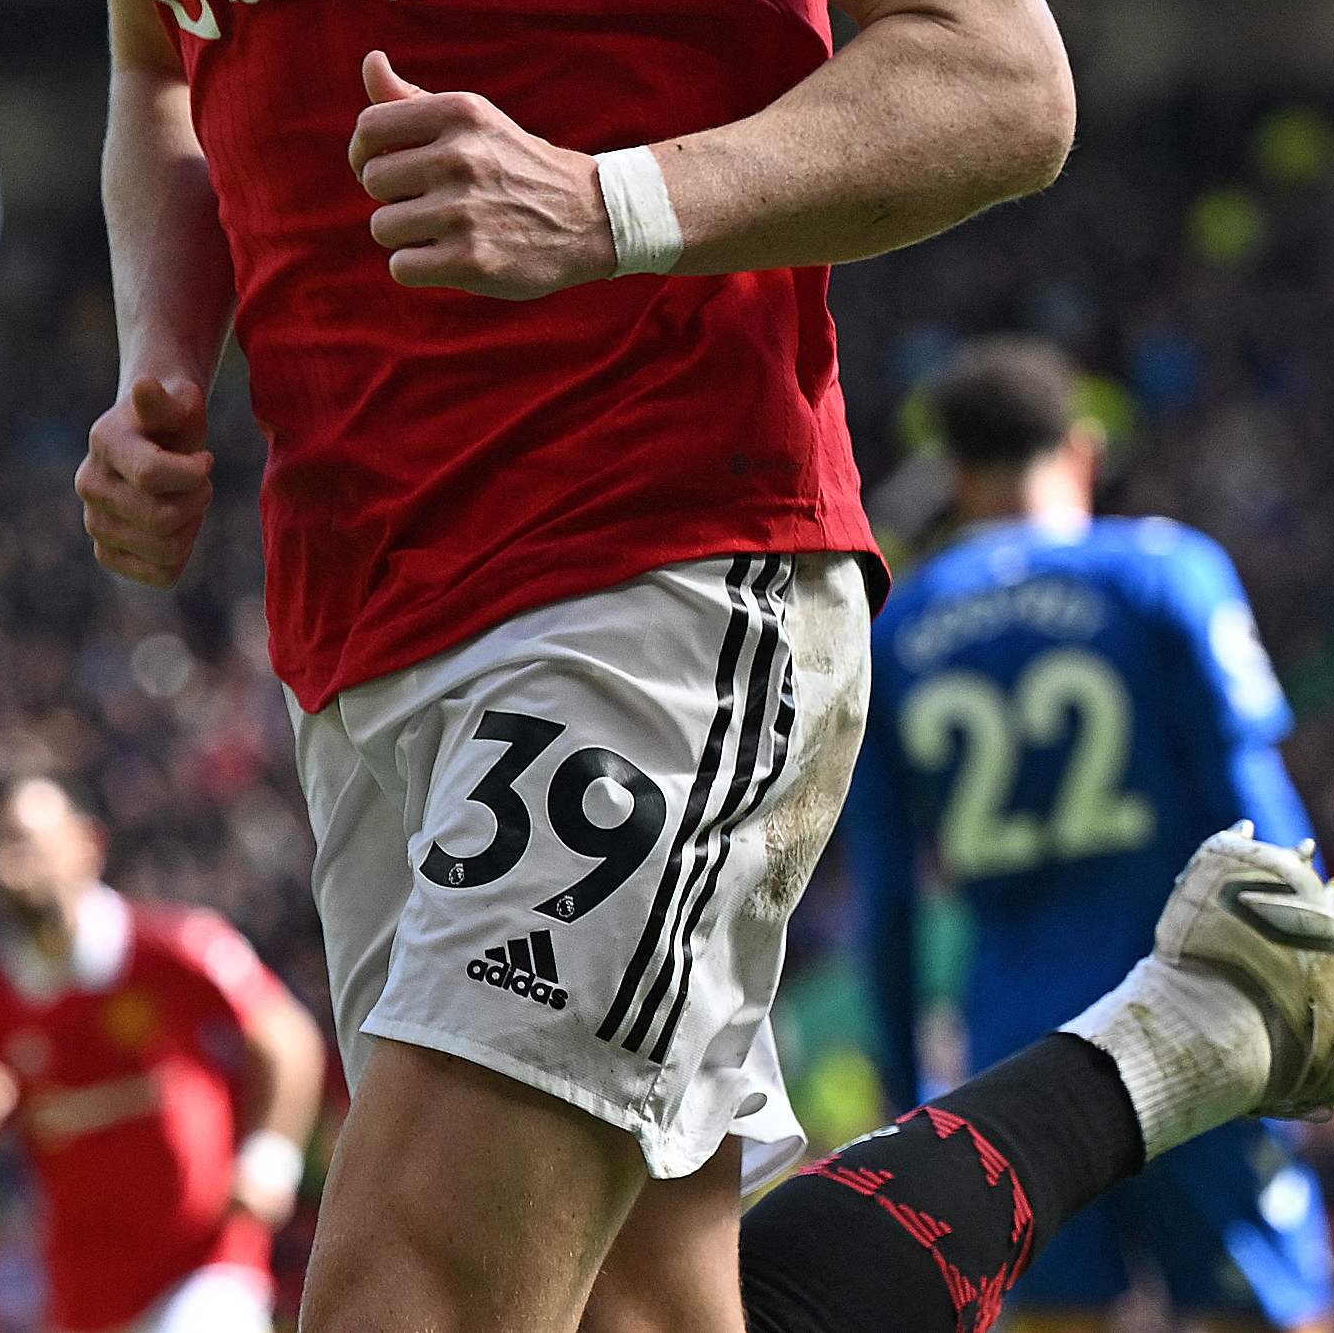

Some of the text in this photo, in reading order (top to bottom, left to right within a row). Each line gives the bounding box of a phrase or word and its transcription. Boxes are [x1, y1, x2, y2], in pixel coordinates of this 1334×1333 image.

[418, 710, 666, 924] 39
[899, 653, 1152, 872] 22
[467, 959, 568, 1010] adidas
